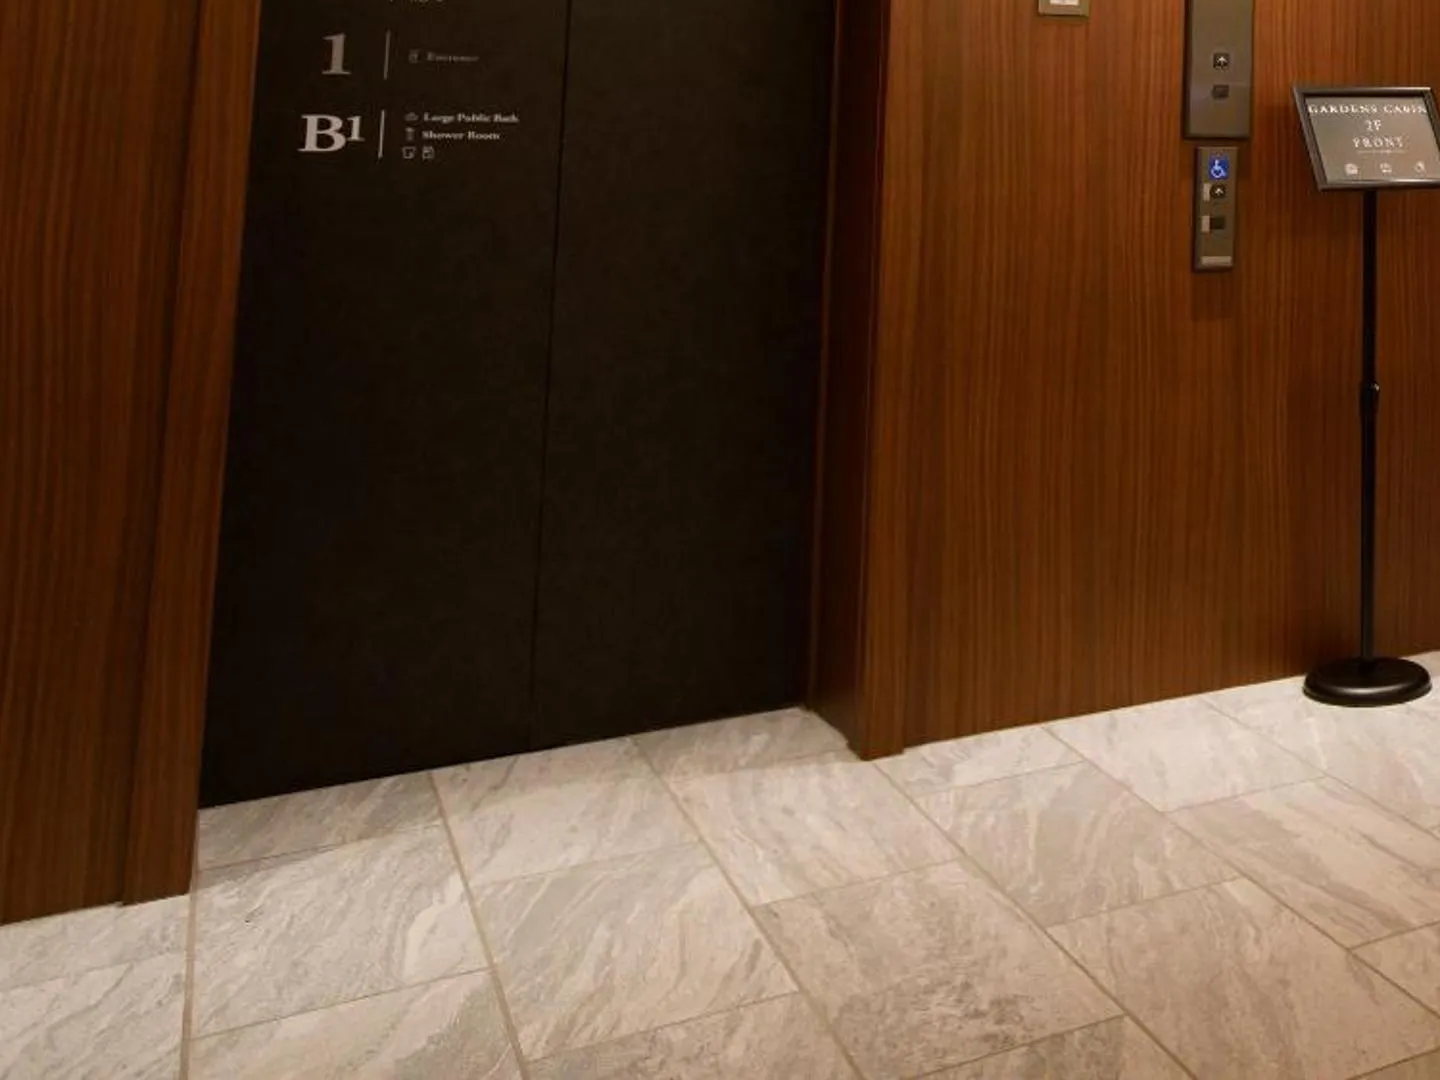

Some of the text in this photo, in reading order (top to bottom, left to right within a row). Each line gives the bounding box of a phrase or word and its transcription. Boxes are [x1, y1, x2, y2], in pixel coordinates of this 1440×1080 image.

[320, 32, 351, 76] 1
[1307, 103, 1428, 114] GARDENS CABIN
[297, 113, 366, 153] B1
[1352, 135, 1405, 149] FRONT
